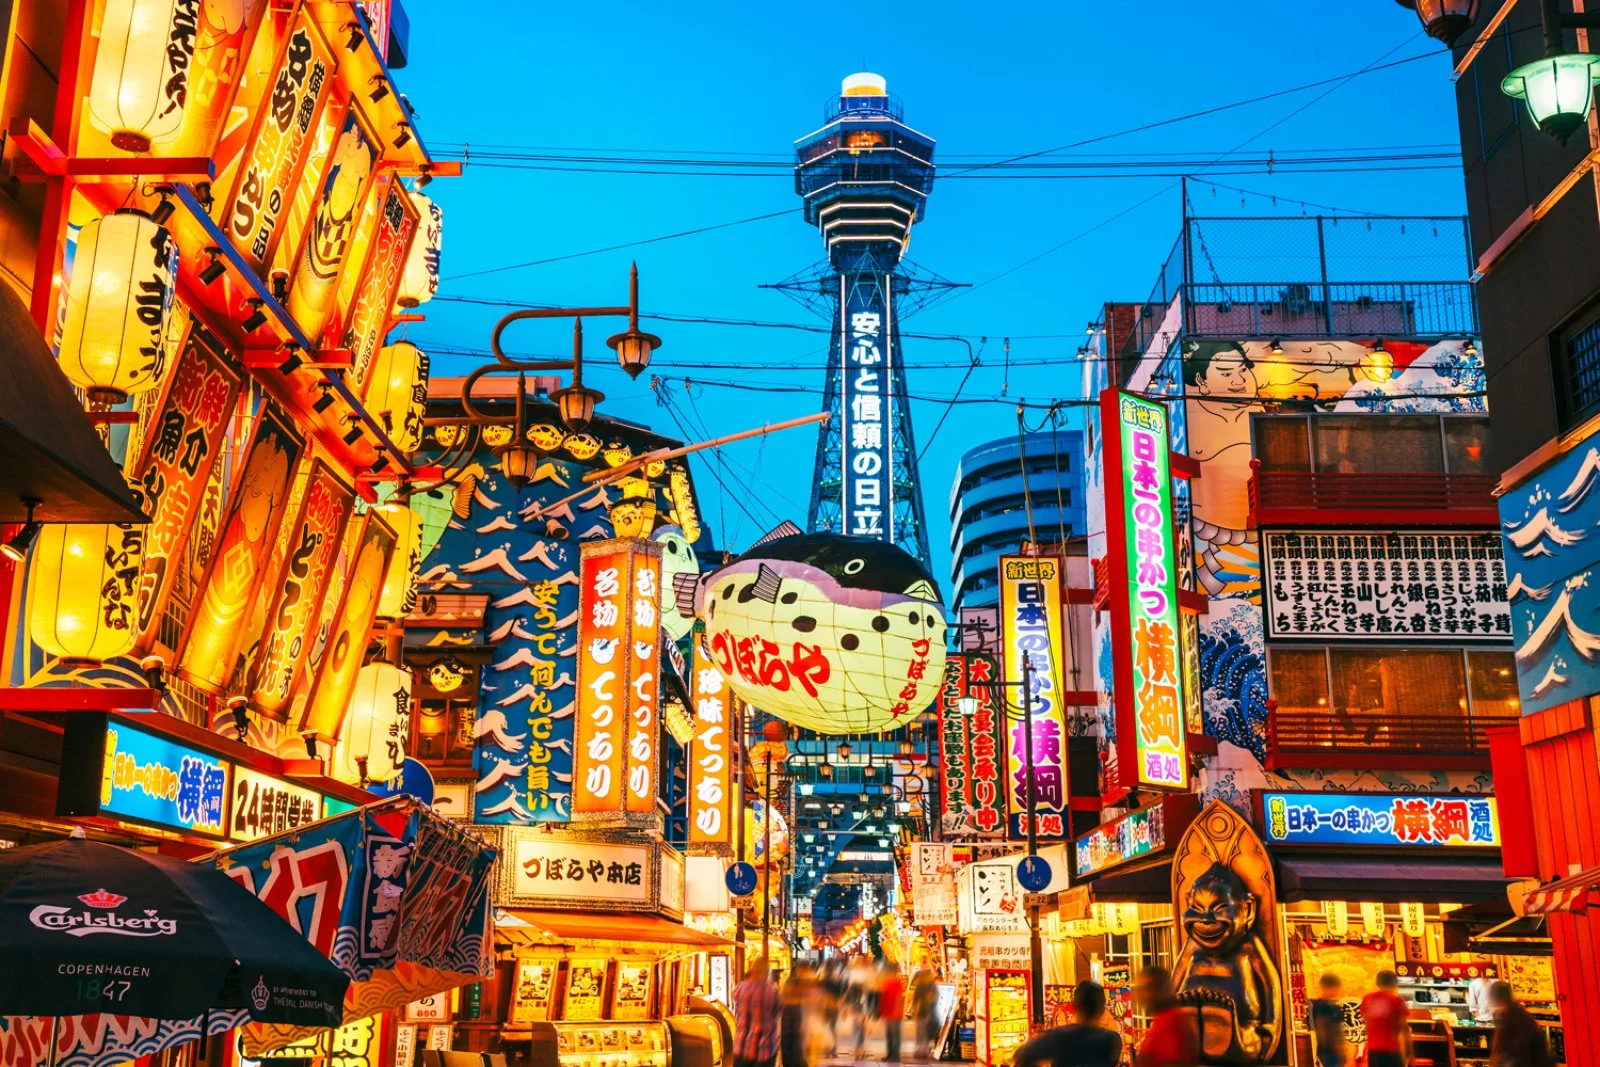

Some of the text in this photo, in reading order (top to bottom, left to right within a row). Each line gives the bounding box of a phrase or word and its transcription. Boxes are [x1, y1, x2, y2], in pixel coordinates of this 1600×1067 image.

[851, 312, 883, 534] 安心と信頼の日立
[1006, 561, 1056, 580] 新世界
[1121, 398, 1182, 781] 新世界 日本一の串かつ 横綱 酒処
[1274, 582, 1291, 632] もち
[1307, 582, 1326, 632] 紅しょうが
[1323, 582, 1341, 632] にんにく
[1340, 582, 1358, 632] 玉ねぎ
[1357, 582, 1376, 632] 山芋
[1374, 582, 1392, 632] しし唐
[1390, 582, 1409, 632] れんこん
[1407, 582, 1425, 632] 銀杏
[1424, 582, 1443, 632] 白ねぎ
[1441, 582, 1460, 633] さつま芋
[1475, 582, 1494, 633] 茄子
[1492, 582, 1511, 633] 椎茸
[586, 567, 620, 798] 名物 てっちり
[630, 567, 655, 799] 名物 てっちり
[711, 629, 831, 699] づぼらや
[890, 637, 932, 719] づぼらや
[527, 579, 560, 810] 安うて何んでも旨い
[695, 667, 726, 836] 珍味てっちり
[1011, 719, 1064, 812] 横綱
[177, 755, 226, 829] 横綱
[235, 779, 315, 838] 24時間営業
[1287, 805, 1391, 832] 日本一の串かつ
[1391, 799, 1472, 842] 横綱
[1469, 801, 1494, 842] 酒処
[523, 857, 642, 885] づぼらや本店
[29, 904, 177, 937] Carlsberg
[58, 963, 151, 977] COPENHAGEN
[76, 980, 131, 1001] 1847
[417, 1010, 437, 1018] 850
